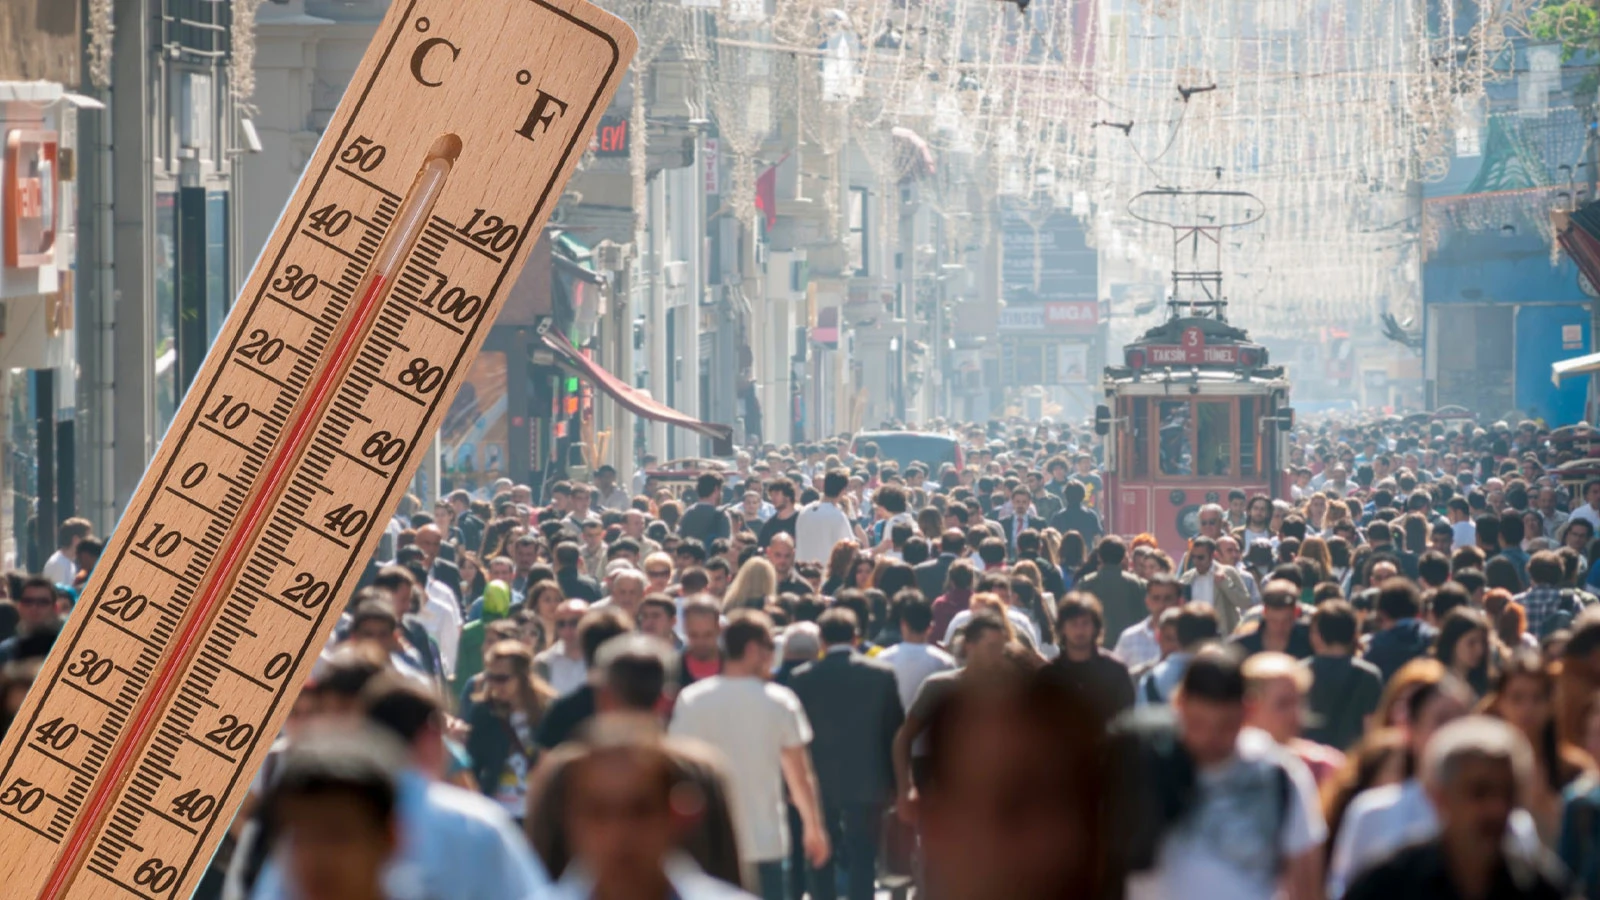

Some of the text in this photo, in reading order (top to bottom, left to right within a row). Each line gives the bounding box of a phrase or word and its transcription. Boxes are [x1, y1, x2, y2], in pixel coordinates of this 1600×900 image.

[340, 135, 386, 172] 50
[309, 203, 351, 237] 40
[455, 209, 518, 253] 120
[272, 265, 318, 302] 30
[419, 279, 481, 323] 100
[236, 329, 285, 365] 20
[1188, 330, 1198, 346] 3
[398, 357, 444, 394] 80
[204, 394, 250, 429] 10
[361, 430, 406, 466] 60
[180, 462, 207, 489] 0
[324, 503, 368, 537] 40
[136, 523, 181, 557] 10
[100, 585, 147, 622] 20
[281, 572, 330, 609] 20
[67, 649, 113, 686] 30
[263, 653, 292, 680] 0
[35, 717, 79, 751] 40
[205, 714, 254, 751] 20
[1, 778, 45, 815] 50
[171, 788, 216, 823] 40
[134, 858, 178, 894] 60
